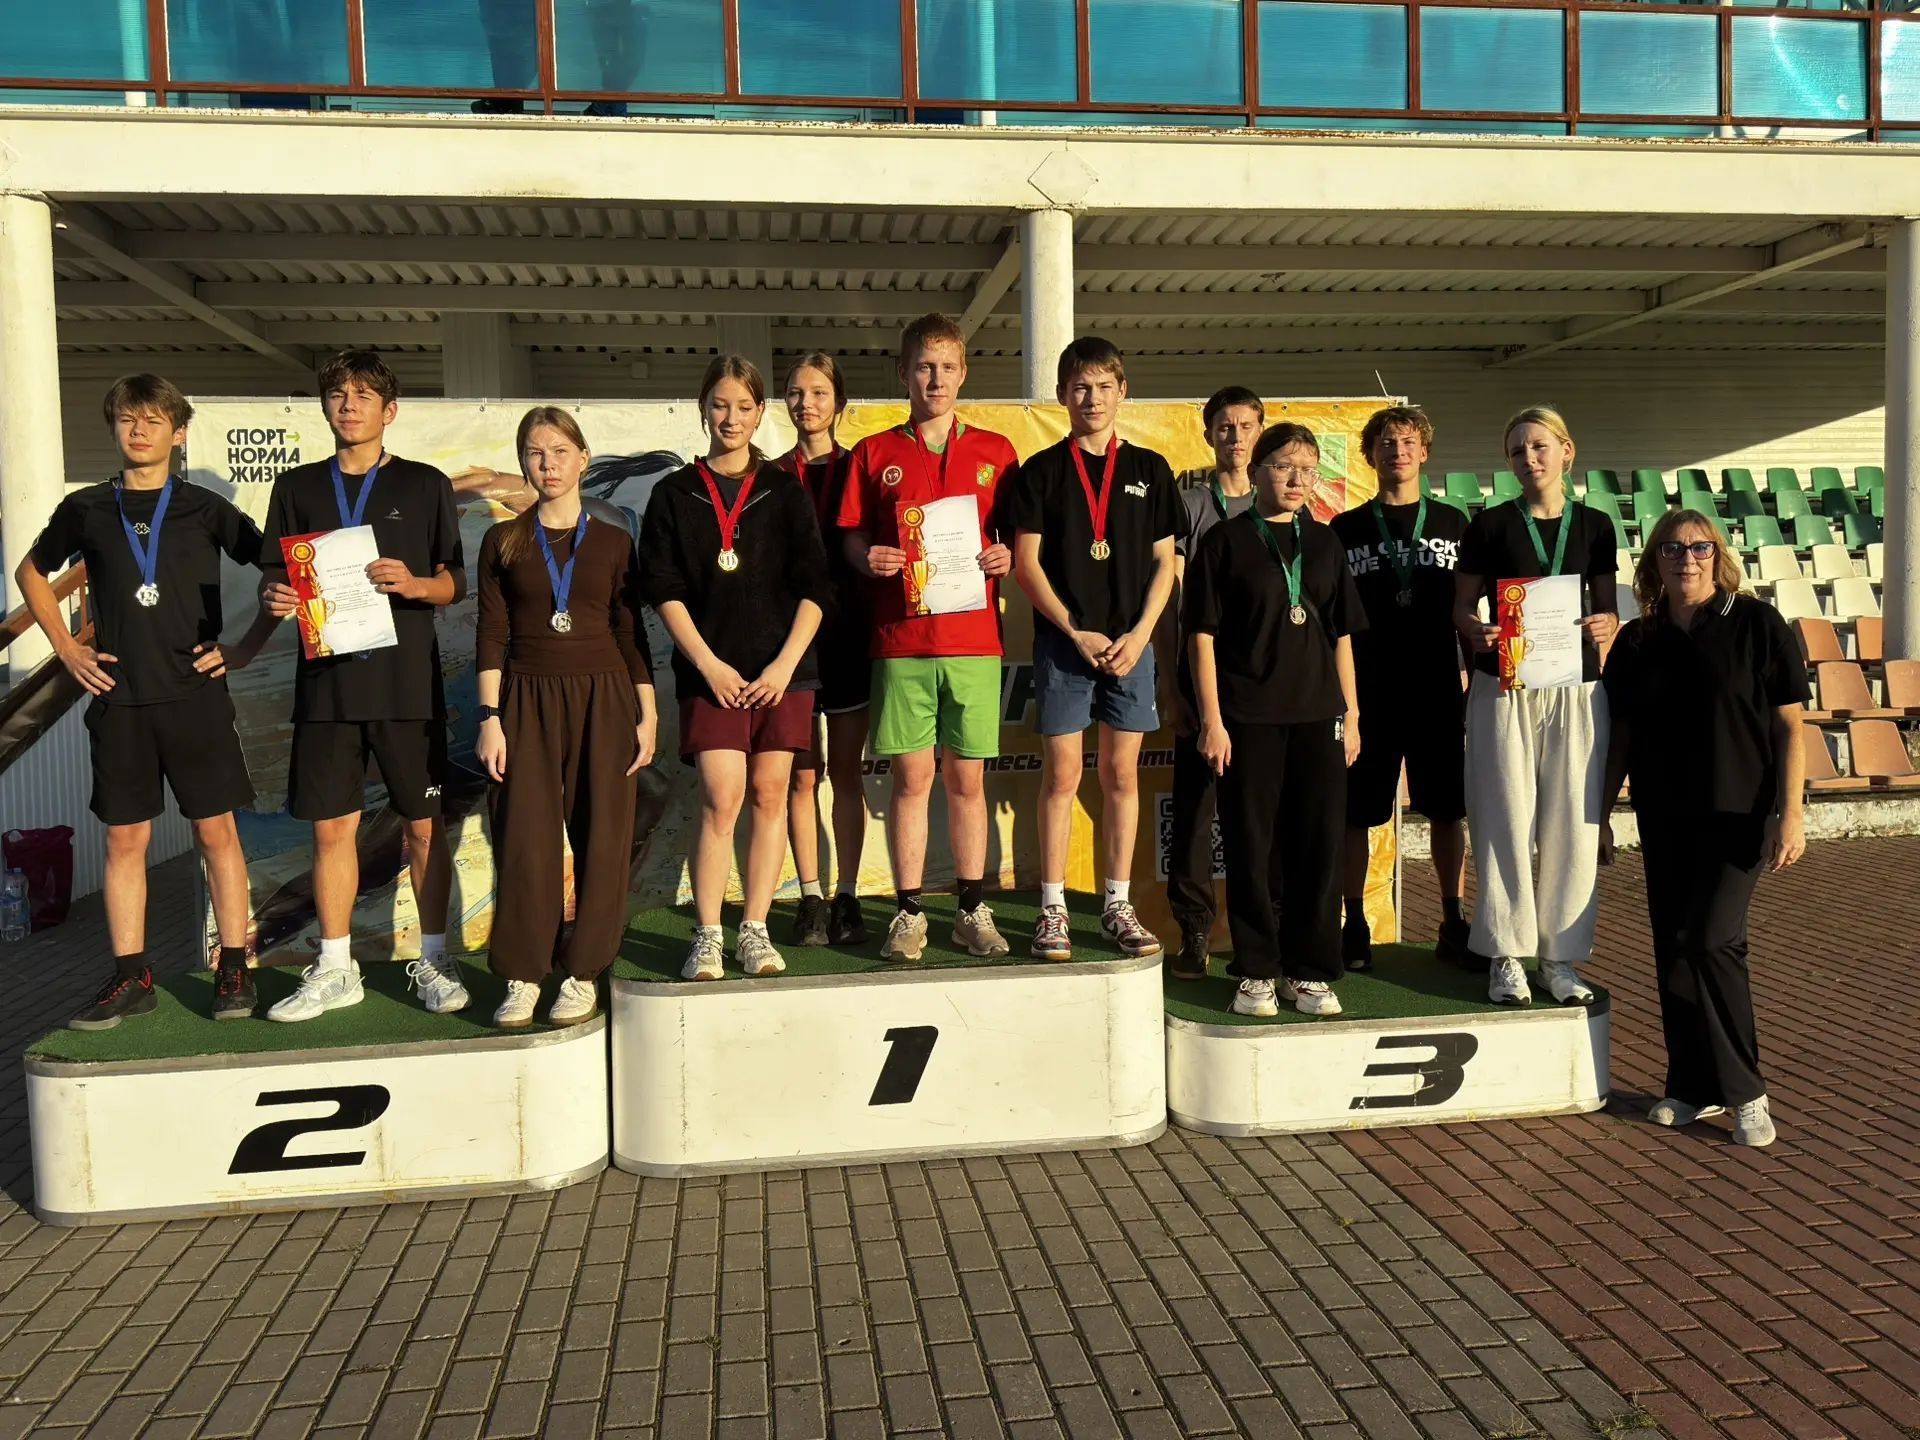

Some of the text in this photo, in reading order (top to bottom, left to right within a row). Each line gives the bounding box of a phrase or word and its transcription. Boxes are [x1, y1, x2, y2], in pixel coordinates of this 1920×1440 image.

[226, 428, 287, 446] СПОРТ
[227, 447, 300, 464] НОРМА
[228, 466, 292, 483] ЖИЗН
[1348, 556, 1380, 576] WE
[868, 1025, 939, 1106] 1
[1349, 1032, 1479, 1110] 3
[227, 1084, 391, 1175] 2
